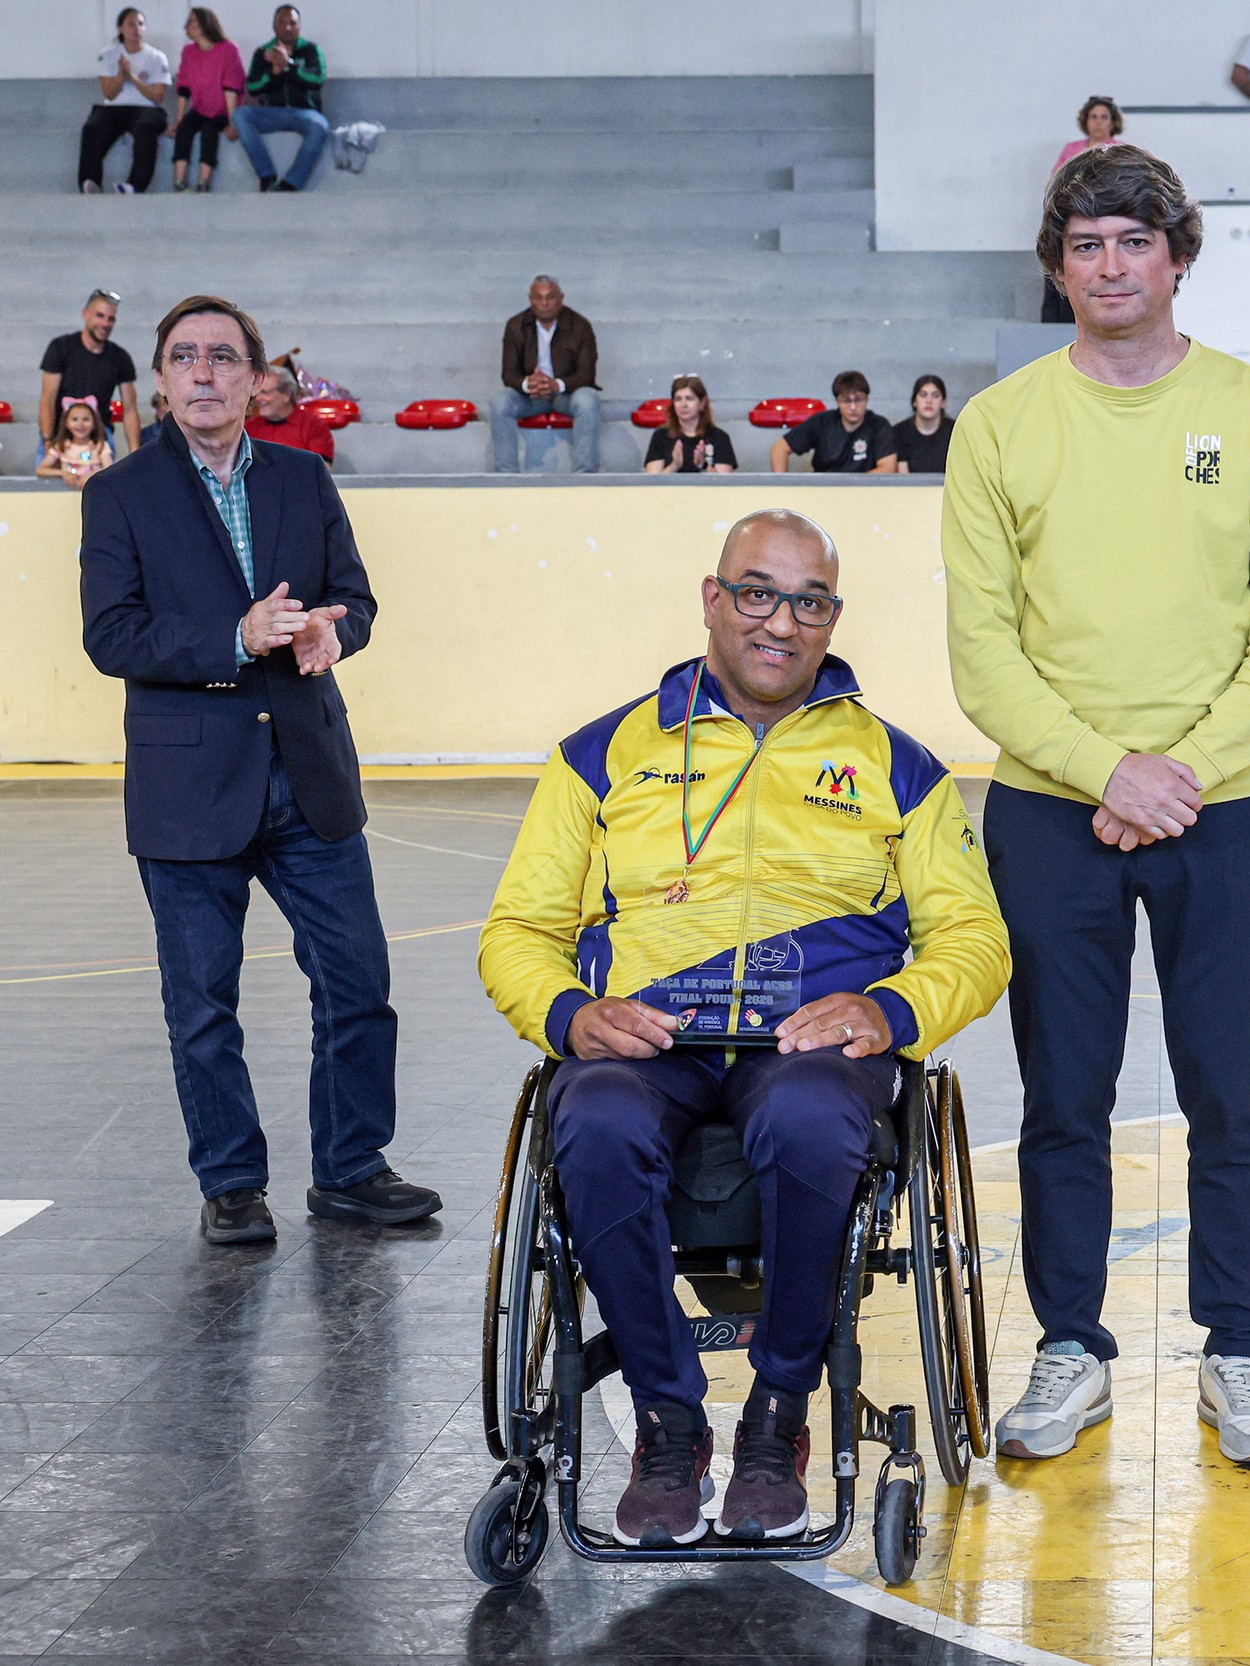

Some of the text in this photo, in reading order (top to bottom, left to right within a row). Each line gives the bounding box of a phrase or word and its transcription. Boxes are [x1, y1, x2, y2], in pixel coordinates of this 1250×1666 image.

[1185, 431, 1222, 451] LION
[803, 794, 862, 815] MESSINES
[651, 978, 681, 990] TAÇA
[683, 978, 699, 988] DE
[701, 979, 760, 990] PORTUGAL
[669, 993, 703, 1003] FINAL
[705, 993, 735, 1004] FOUR
